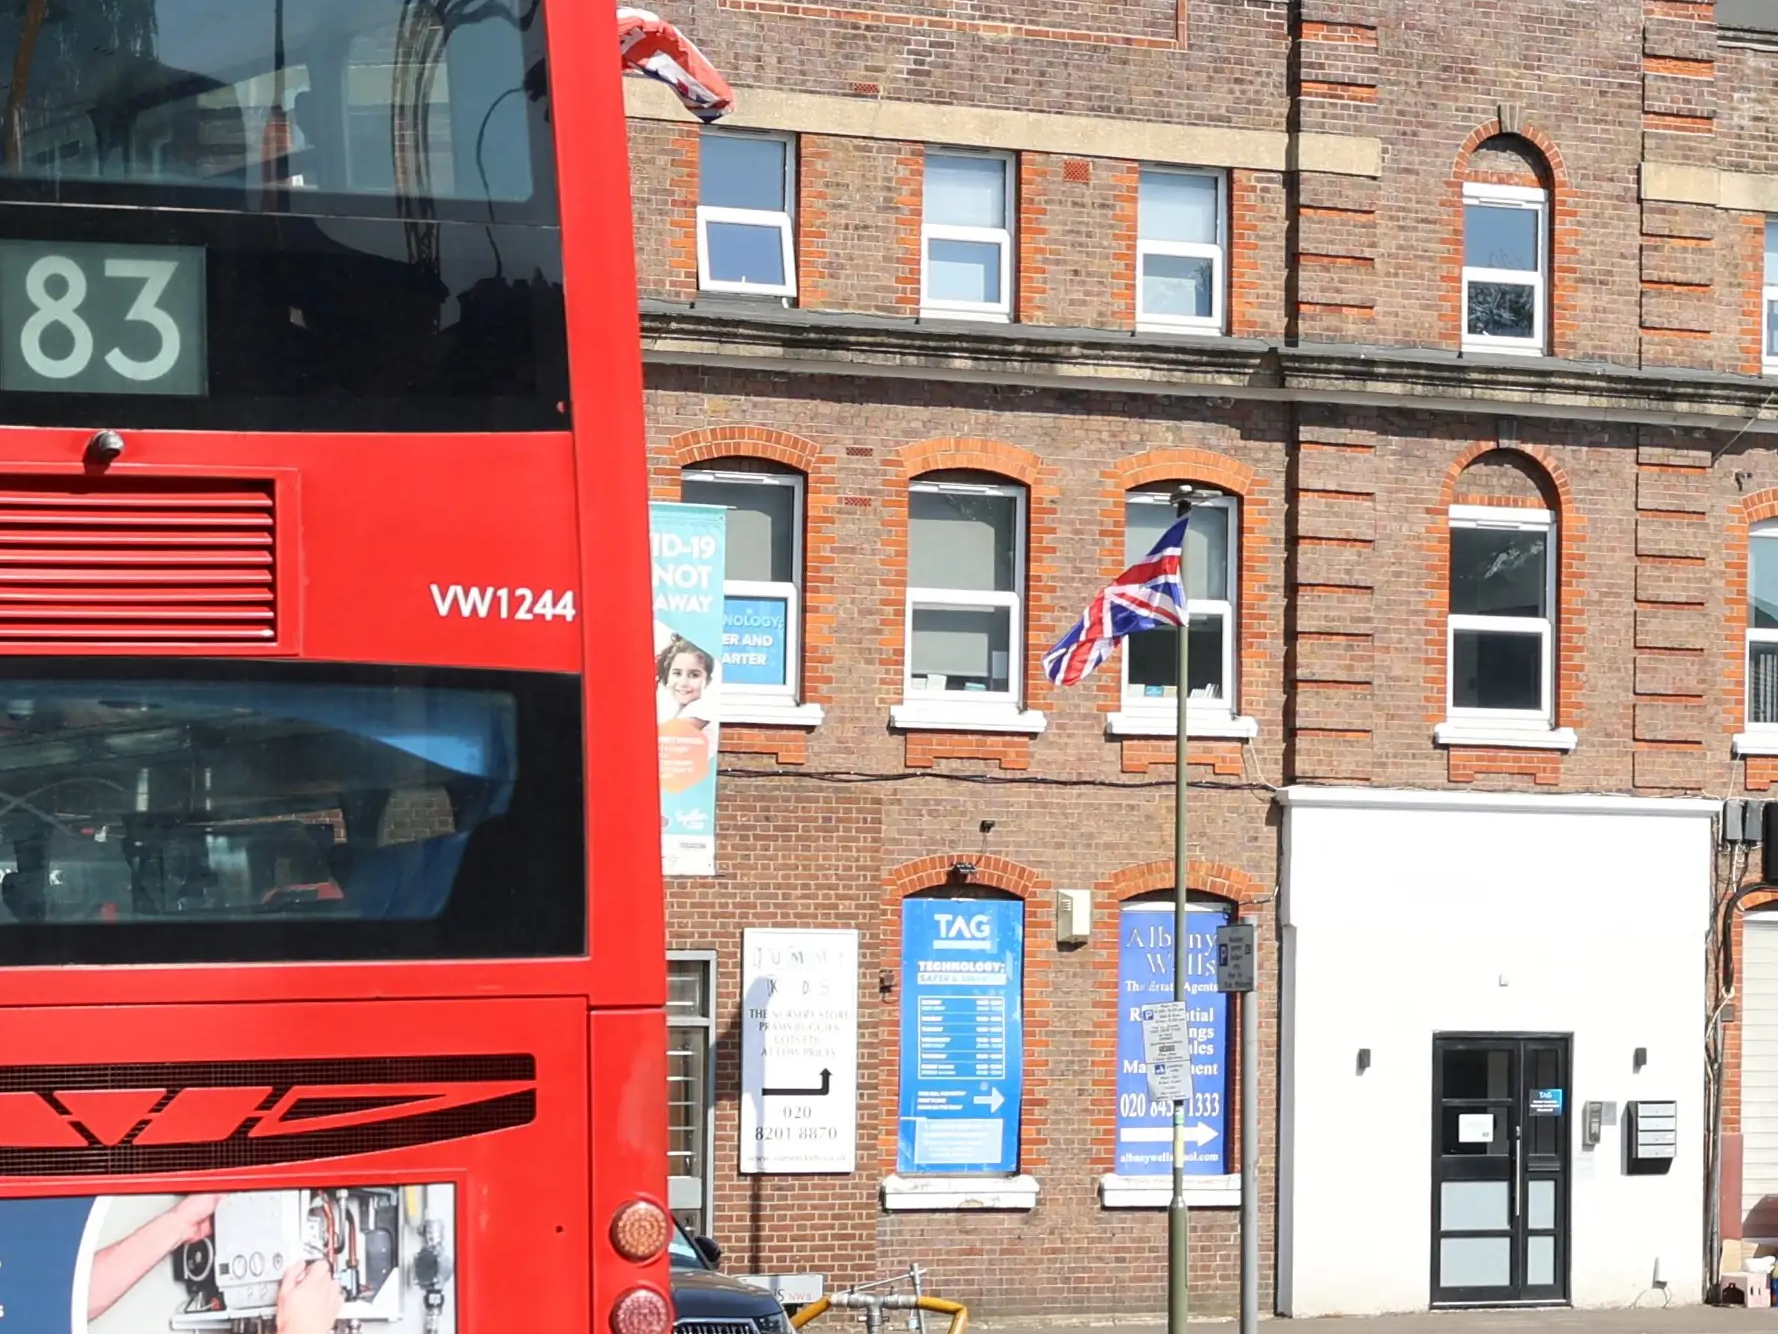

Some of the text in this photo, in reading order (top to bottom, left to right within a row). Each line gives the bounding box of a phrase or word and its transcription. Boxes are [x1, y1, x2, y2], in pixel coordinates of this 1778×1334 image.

[19, 254, 182, 381] 83
[649, 531, 716, 560] ID-19
[653, 560, 713, 592] NOT
[429, 583, 577, 622] VW1244
[653, 593, 713, 614] AWAY
[742, 633, 773, 647] AND
[933, 913, 991, 938] TAG
[1126, 926, 1217, 956] Albny
[1146, 953, 1216, 976] Wlls
[1184, 982, 1218, 994] Agents
[750, 1009, 768, 1019] THE
[782, 1106, 811, 1119] 020
[1120, 1093, 1146, 1117] 020
[756, 1126, 837, 1140] 8201 8870
